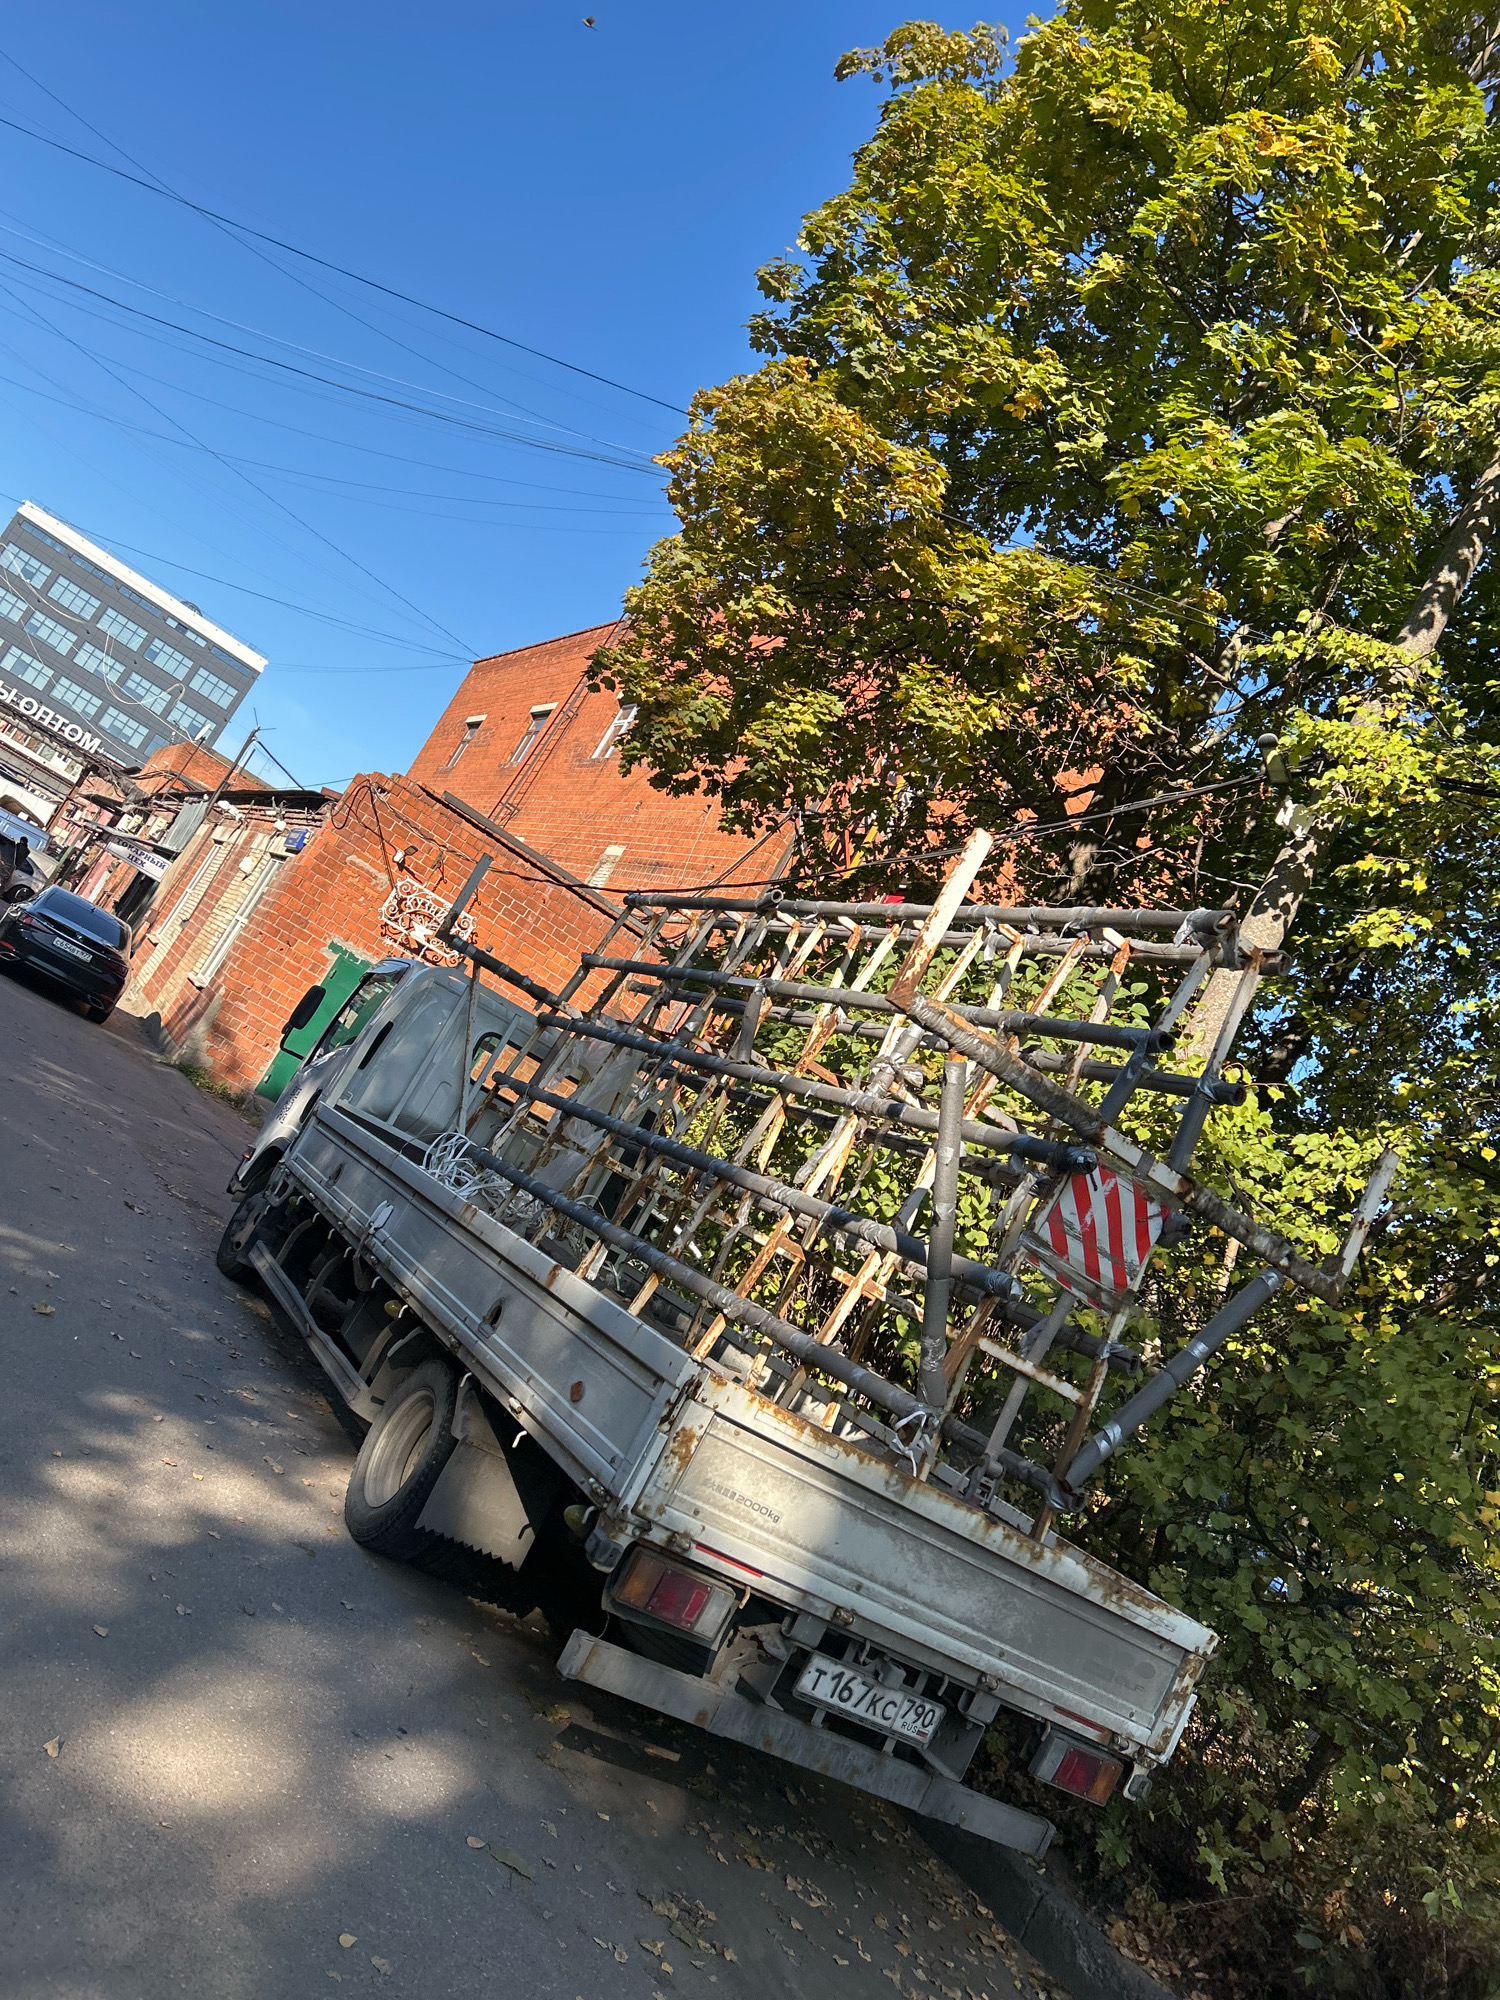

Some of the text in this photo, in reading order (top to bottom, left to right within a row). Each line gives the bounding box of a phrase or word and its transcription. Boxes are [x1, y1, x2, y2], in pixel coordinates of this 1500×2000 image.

[19, 696, 102, 754] ОПТОМ
[115, 838, 167, 871] ТОКАРНЫЙ
[127, 852, 147, 869] ЦЕХ
[736, 1494, 780, 1523] 2000kg
[812, 1668, 936, 1728] Т167КС 790
[901, 1722, 918, 1734] RUS
